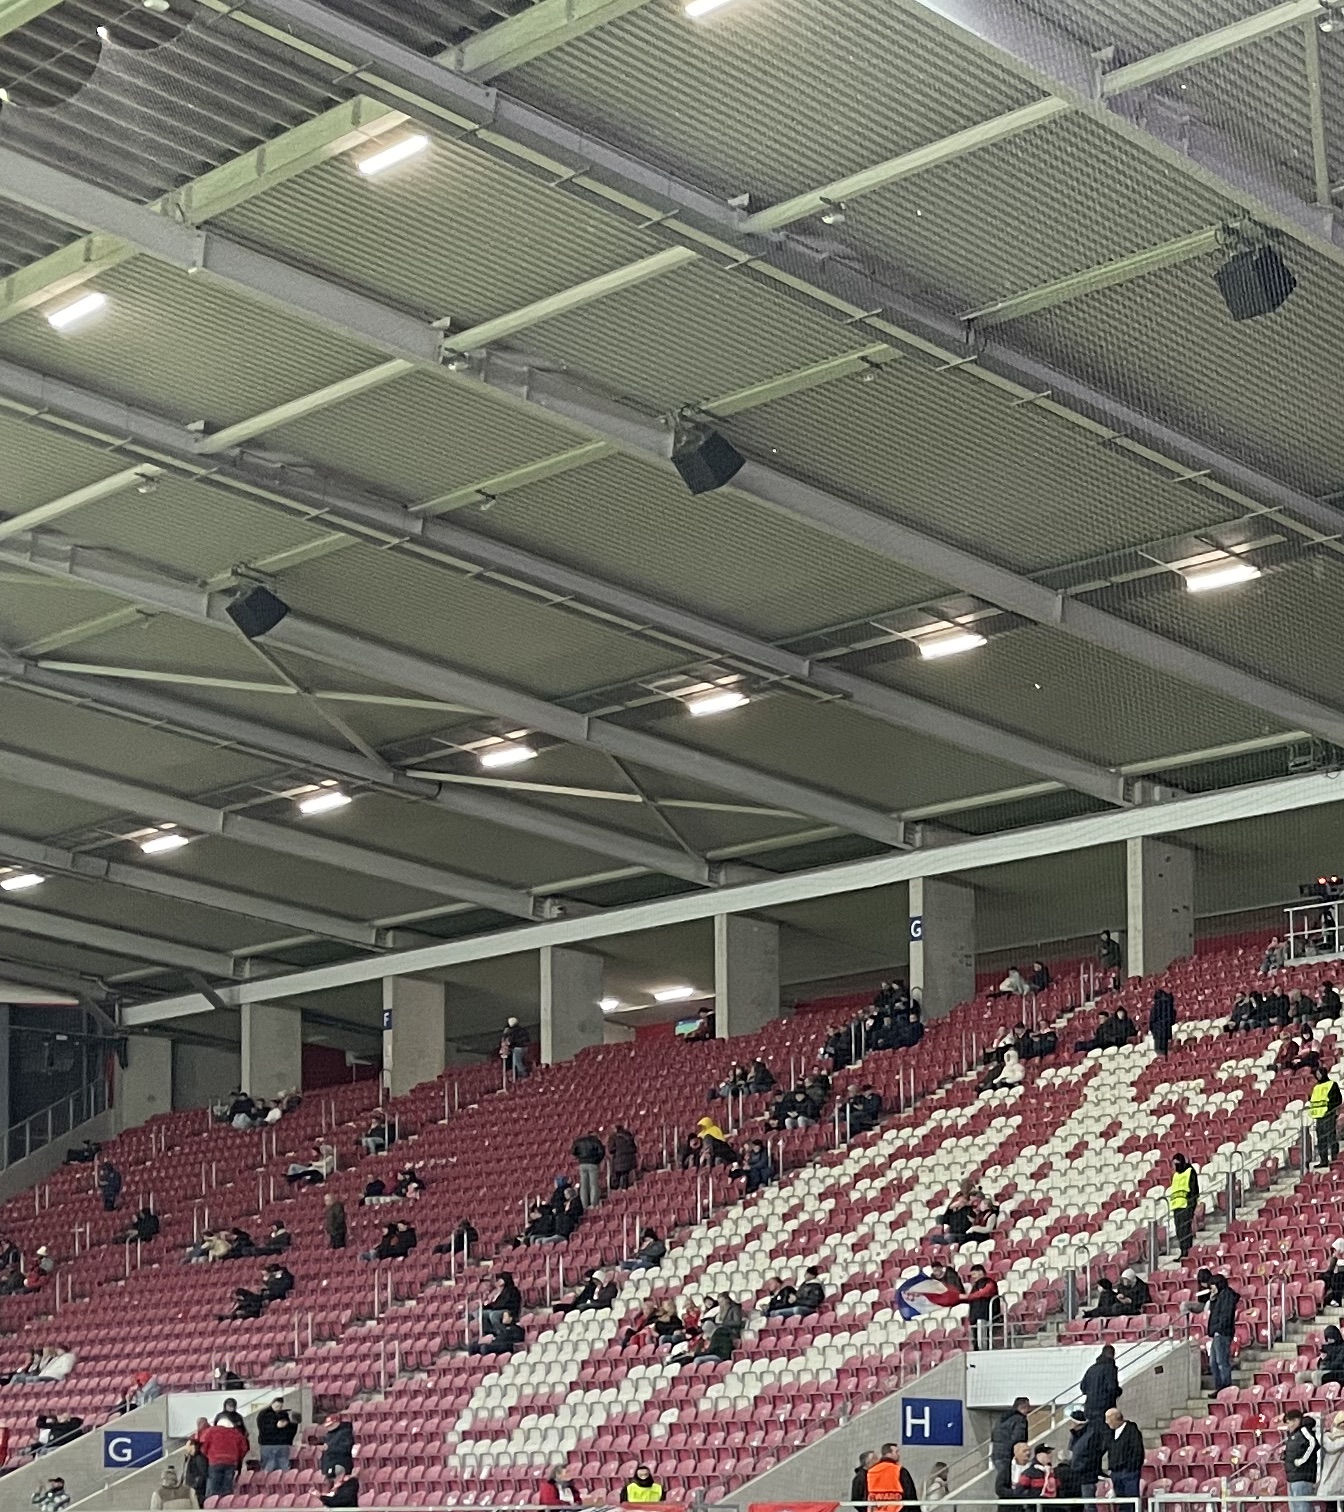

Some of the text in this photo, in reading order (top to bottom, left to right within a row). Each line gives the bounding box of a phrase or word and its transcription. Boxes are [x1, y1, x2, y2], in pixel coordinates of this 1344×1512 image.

[910, 919, 922, 938] G
[383, 1011, 391, 1027] F
[905, 1405, 931, 1438] H
[107, 1437, 133, 1463] G
